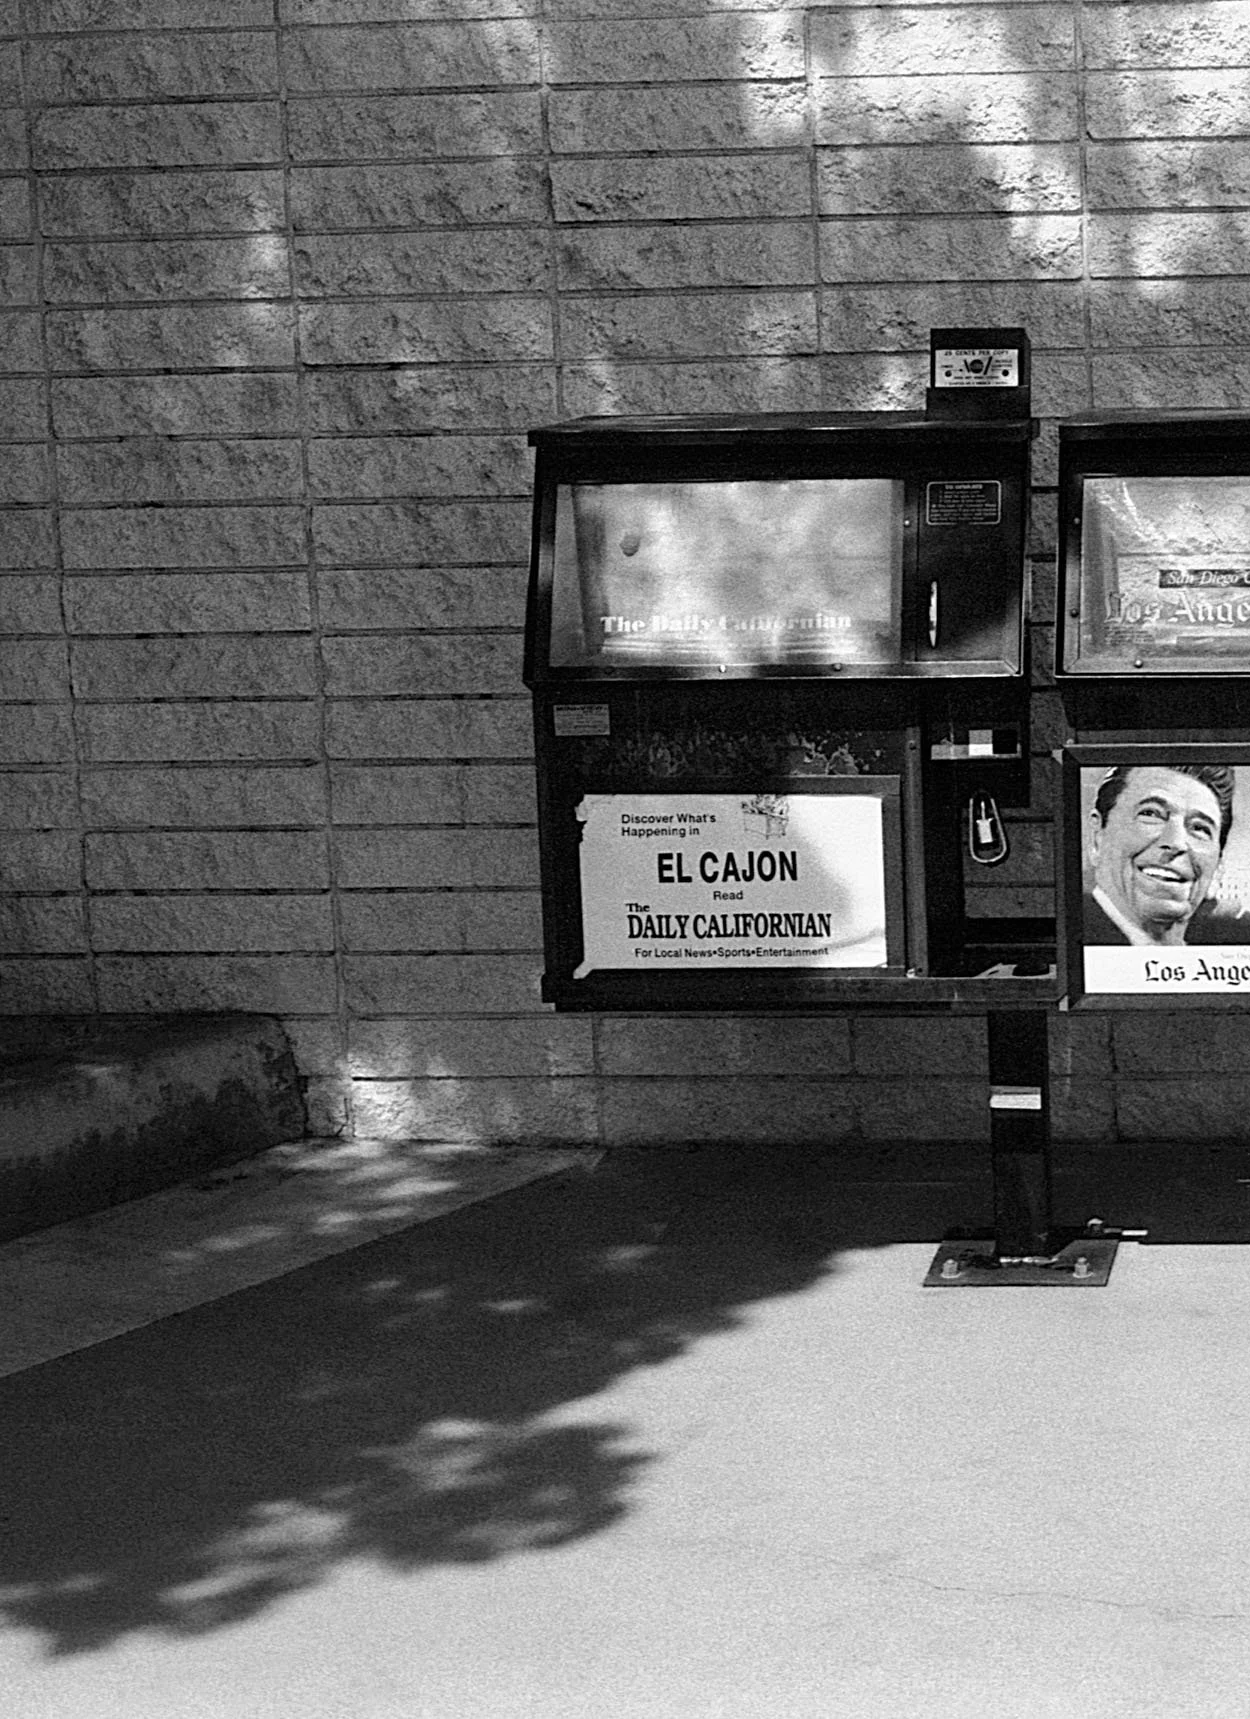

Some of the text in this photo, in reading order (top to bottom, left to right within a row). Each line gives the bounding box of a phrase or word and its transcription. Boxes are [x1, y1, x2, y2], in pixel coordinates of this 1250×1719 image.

[1168, 571, 1194, 585] San
[1200, 570, 1240, 588] Diego
[601, 615, 646, 633] The
[621, 813, 716, 824] Discover What's
[621, 826, 700, 838] Happening in
[657, 850, 798, 883] EL CAJON
[713, 891, 743, 900] Read
[625, 903, 650, 912] The
[627, 912, 832, 939] DAILY CALIFORNIAN
[635, 948, 652, 958] For
[655, 948, 682, 958] Local
[1144, 960, 1186, 982] Los
